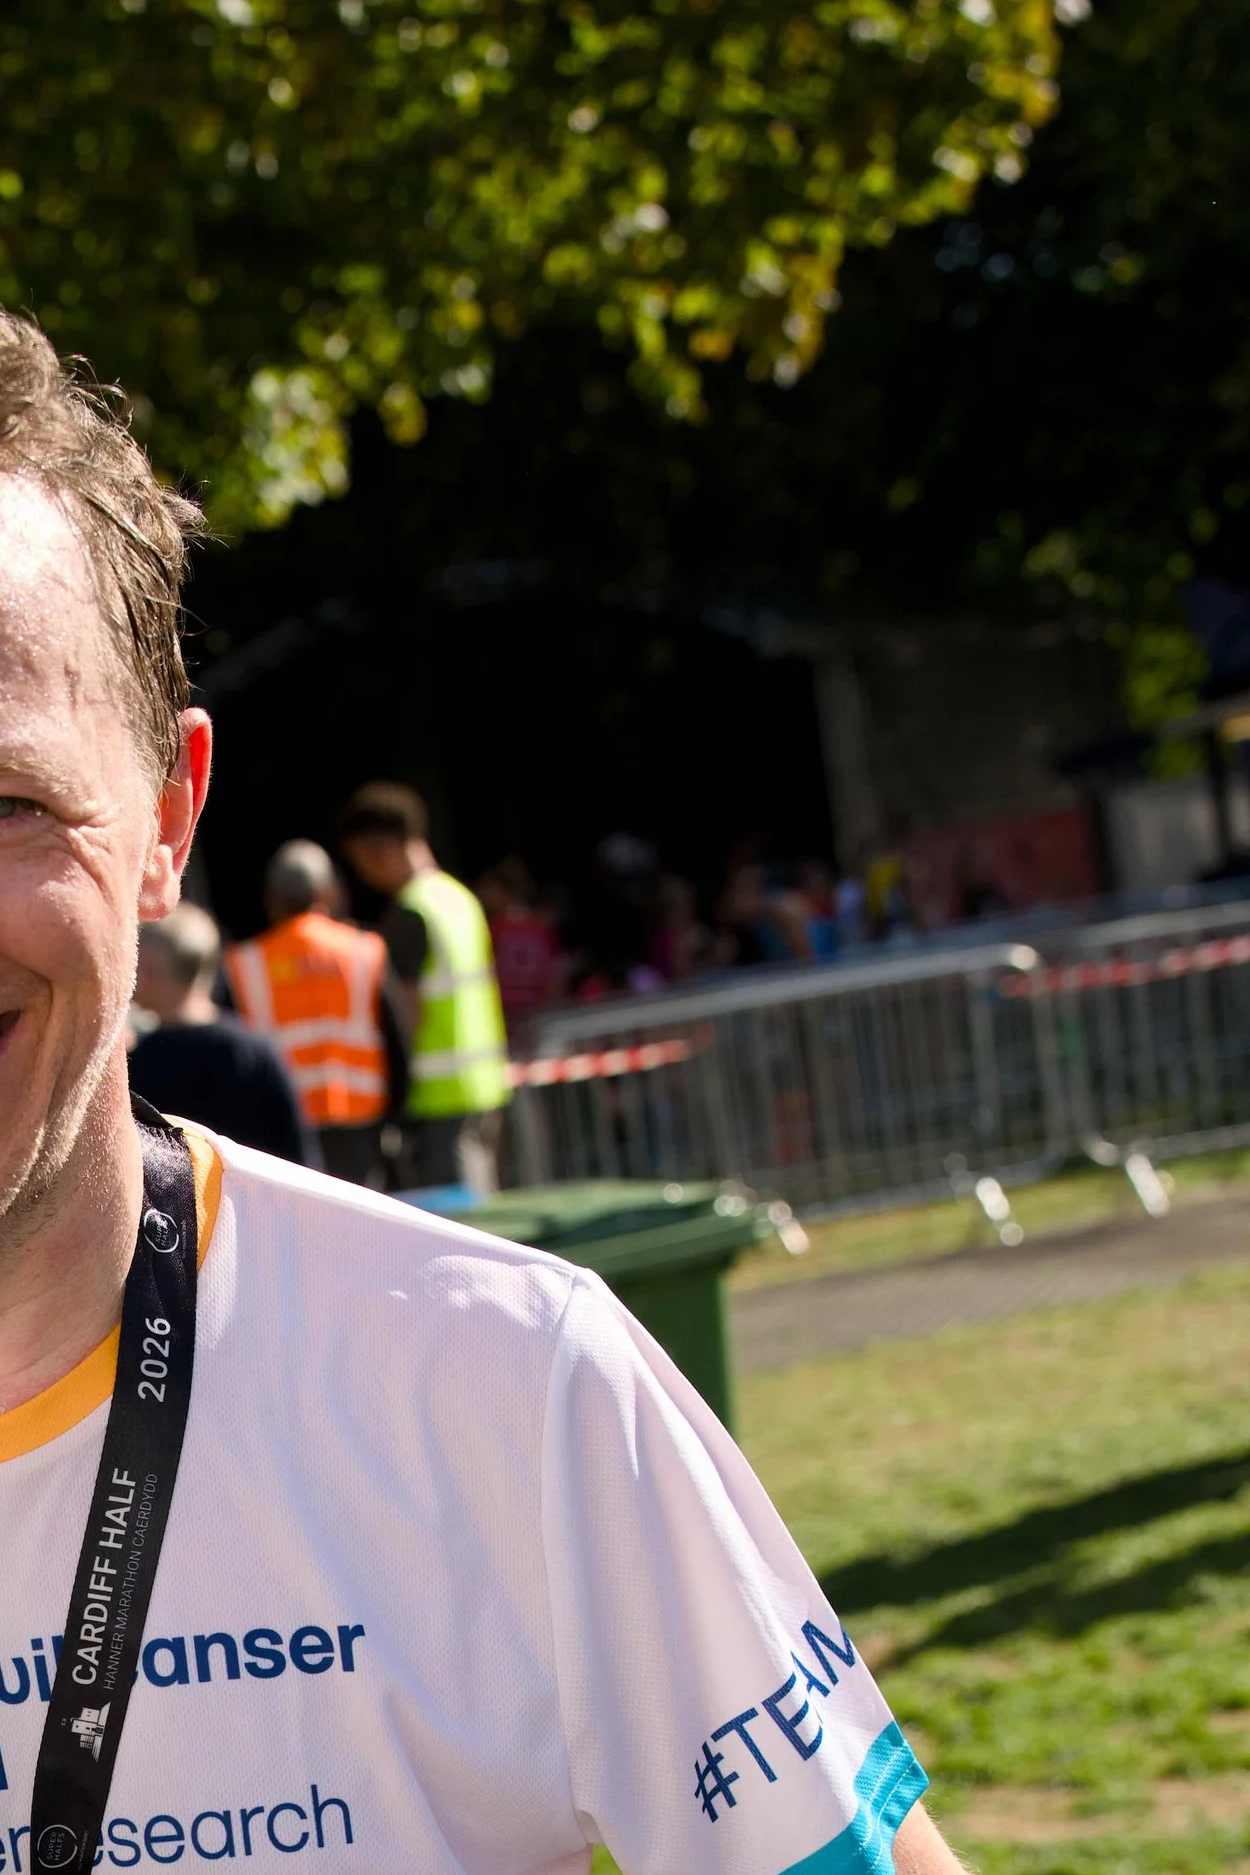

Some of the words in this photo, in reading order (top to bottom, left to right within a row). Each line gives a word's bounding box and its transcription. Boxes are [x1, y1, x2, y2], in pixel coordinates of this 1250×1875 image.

[137, 1317, 171, 1403] 2026
[72, 1555, 118, 1685] CARDIFF
[98, 1467, 137, 1549] HALF
[103, 1631, 126, 1691] HANNER
[115, 1550, 142, 1630] MARATHON
[132, 1472, 159, 1547] CAERDYDD
[132, 1624, 366, 1688] anser
[694, 1619, 857, 1823] #TEAM
[93, 1784, 354, 1868] search
